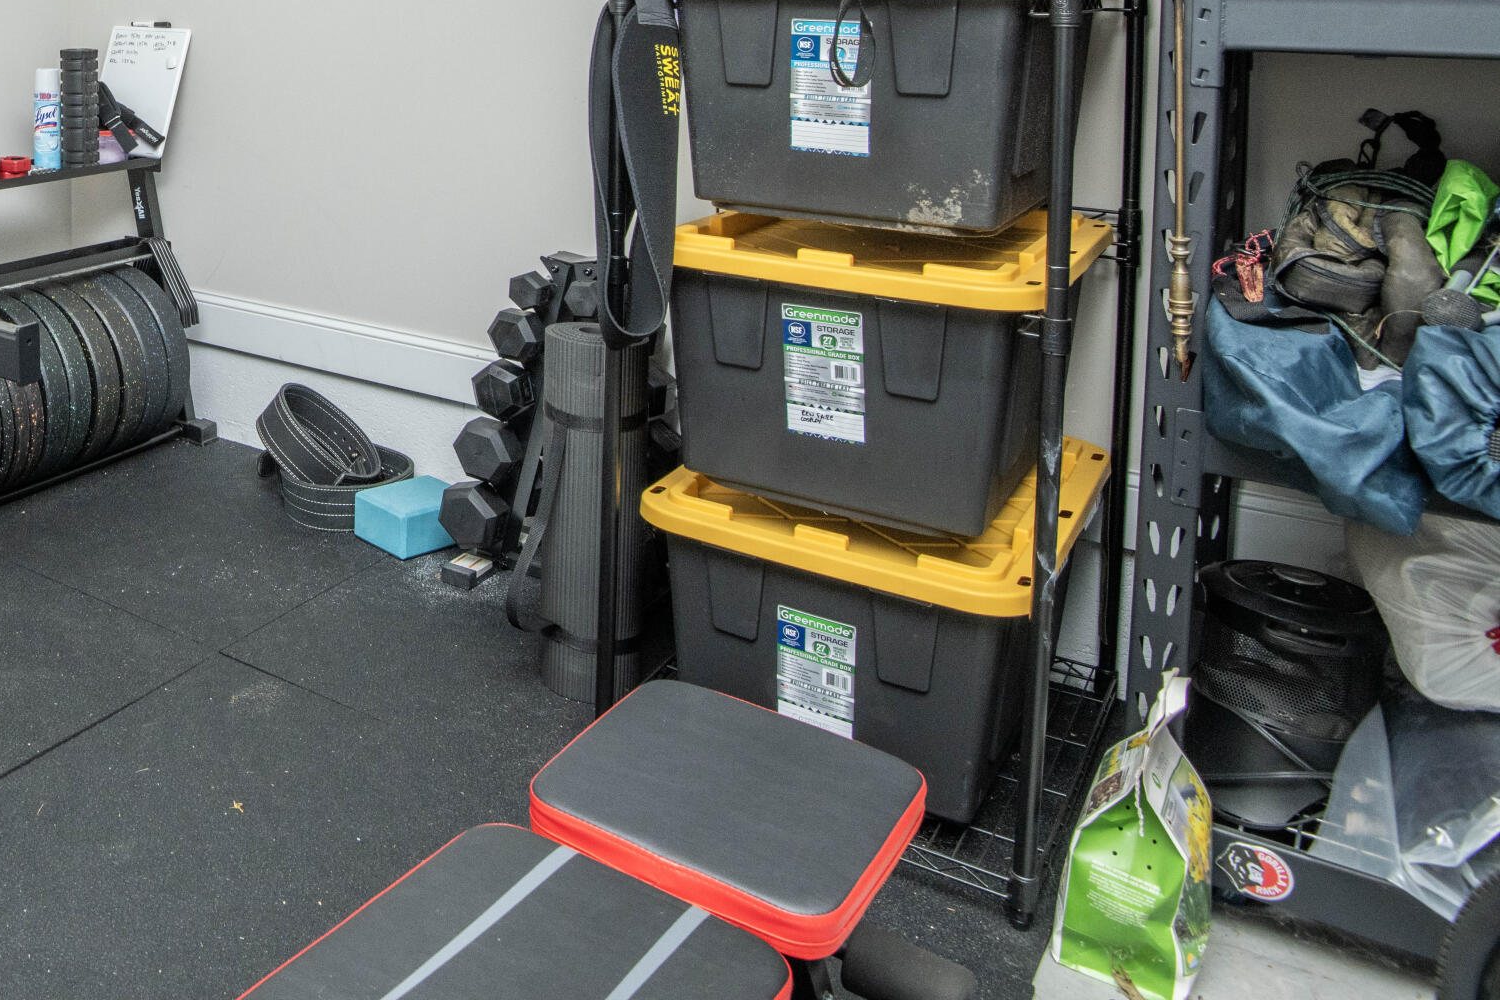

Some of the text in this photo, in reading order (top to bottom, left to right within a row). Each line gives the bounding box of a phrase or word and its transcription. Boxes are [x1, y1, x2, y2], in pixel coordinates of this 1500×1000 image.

[660, 44, 677, 116] SWEAT
[35, 107, 57, 123] Lysol
[785, 307, 856, 325] Greenmade
[816, 325, 856, 336] STORAGE
[822, 336, 833, 345] 27
[780, 609, 850, 637] Greenmade
[810, 631, 849, 648] STORAGE
[815, 643, 827, 653] 27
[839, 664, 852, 673] BOX
[1257, 852, 1288, 888] GORILLA
[1256, 885, 1282, 896] RACK
